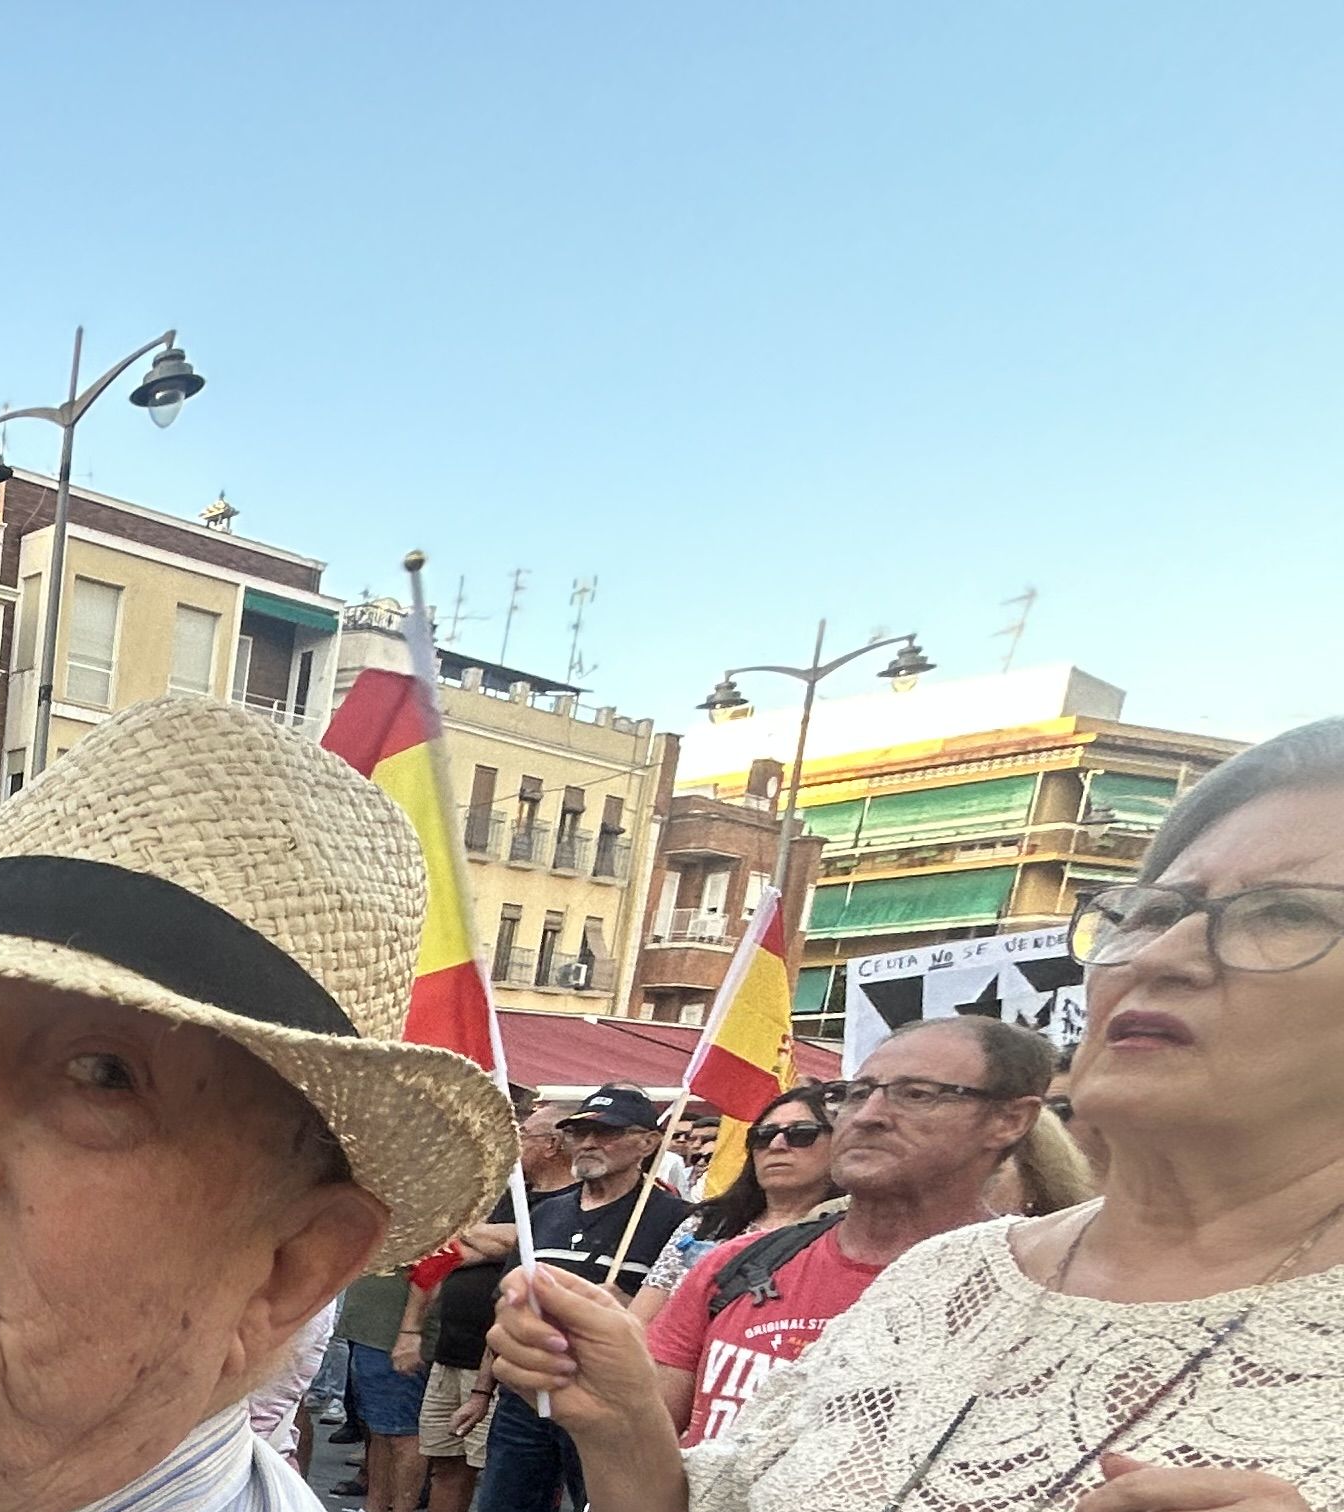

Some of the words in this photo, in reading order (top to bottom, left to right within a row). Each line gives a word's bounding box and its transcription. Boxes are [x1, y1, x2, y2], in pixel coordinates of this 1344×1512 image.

[859, 954, 918, 978] CEUTA
[931, 949, 954, 966] NO
[964, 941, 989, 959] SE
[744, 1318, 806, 1339] ORIGINAL
